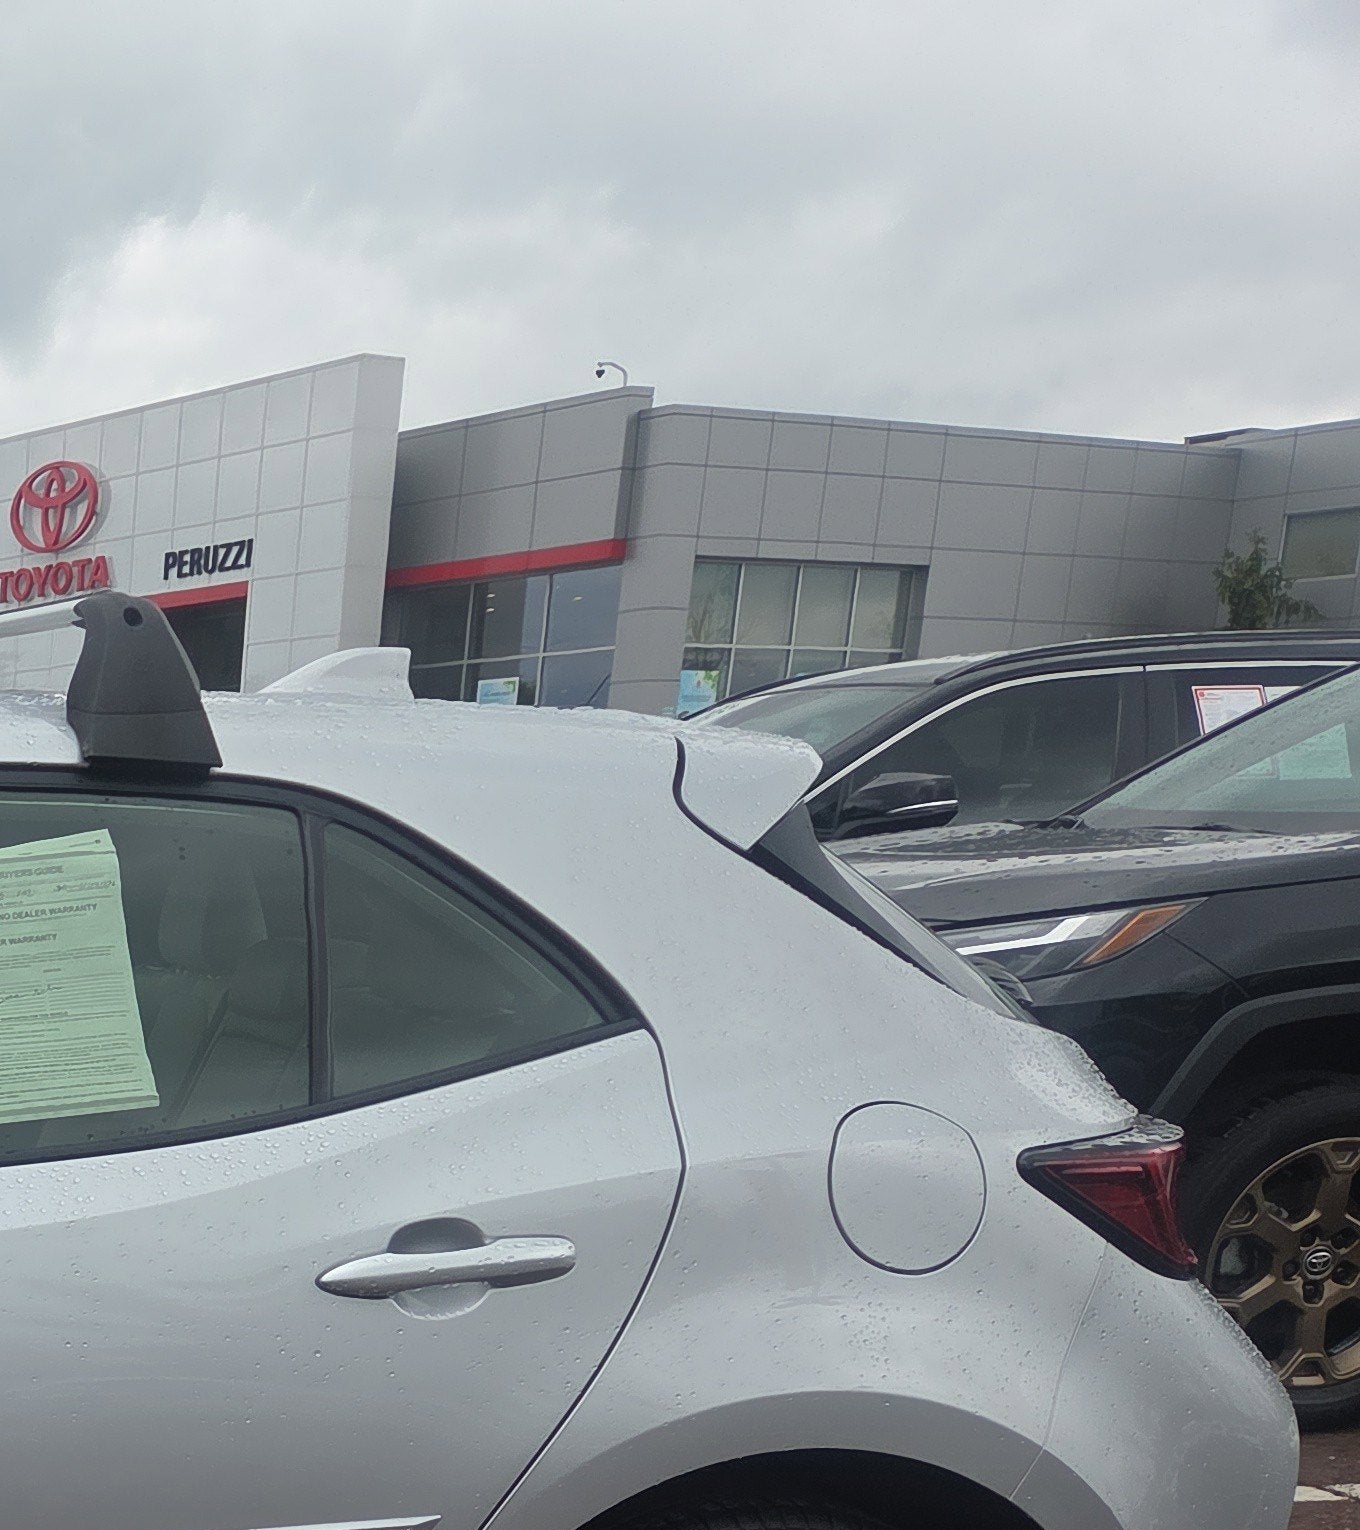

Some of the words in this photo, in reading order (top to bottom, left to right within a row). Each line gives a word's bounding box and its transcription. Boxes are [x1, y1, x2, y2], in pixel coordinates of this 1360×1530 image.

[163, 538, 254, 580] PERUZZI
[12, 908, 48, 920] DEALER
[49, 902, 98, 916] WARRANTY
[8, 932, 58, 946] WARRANTY
